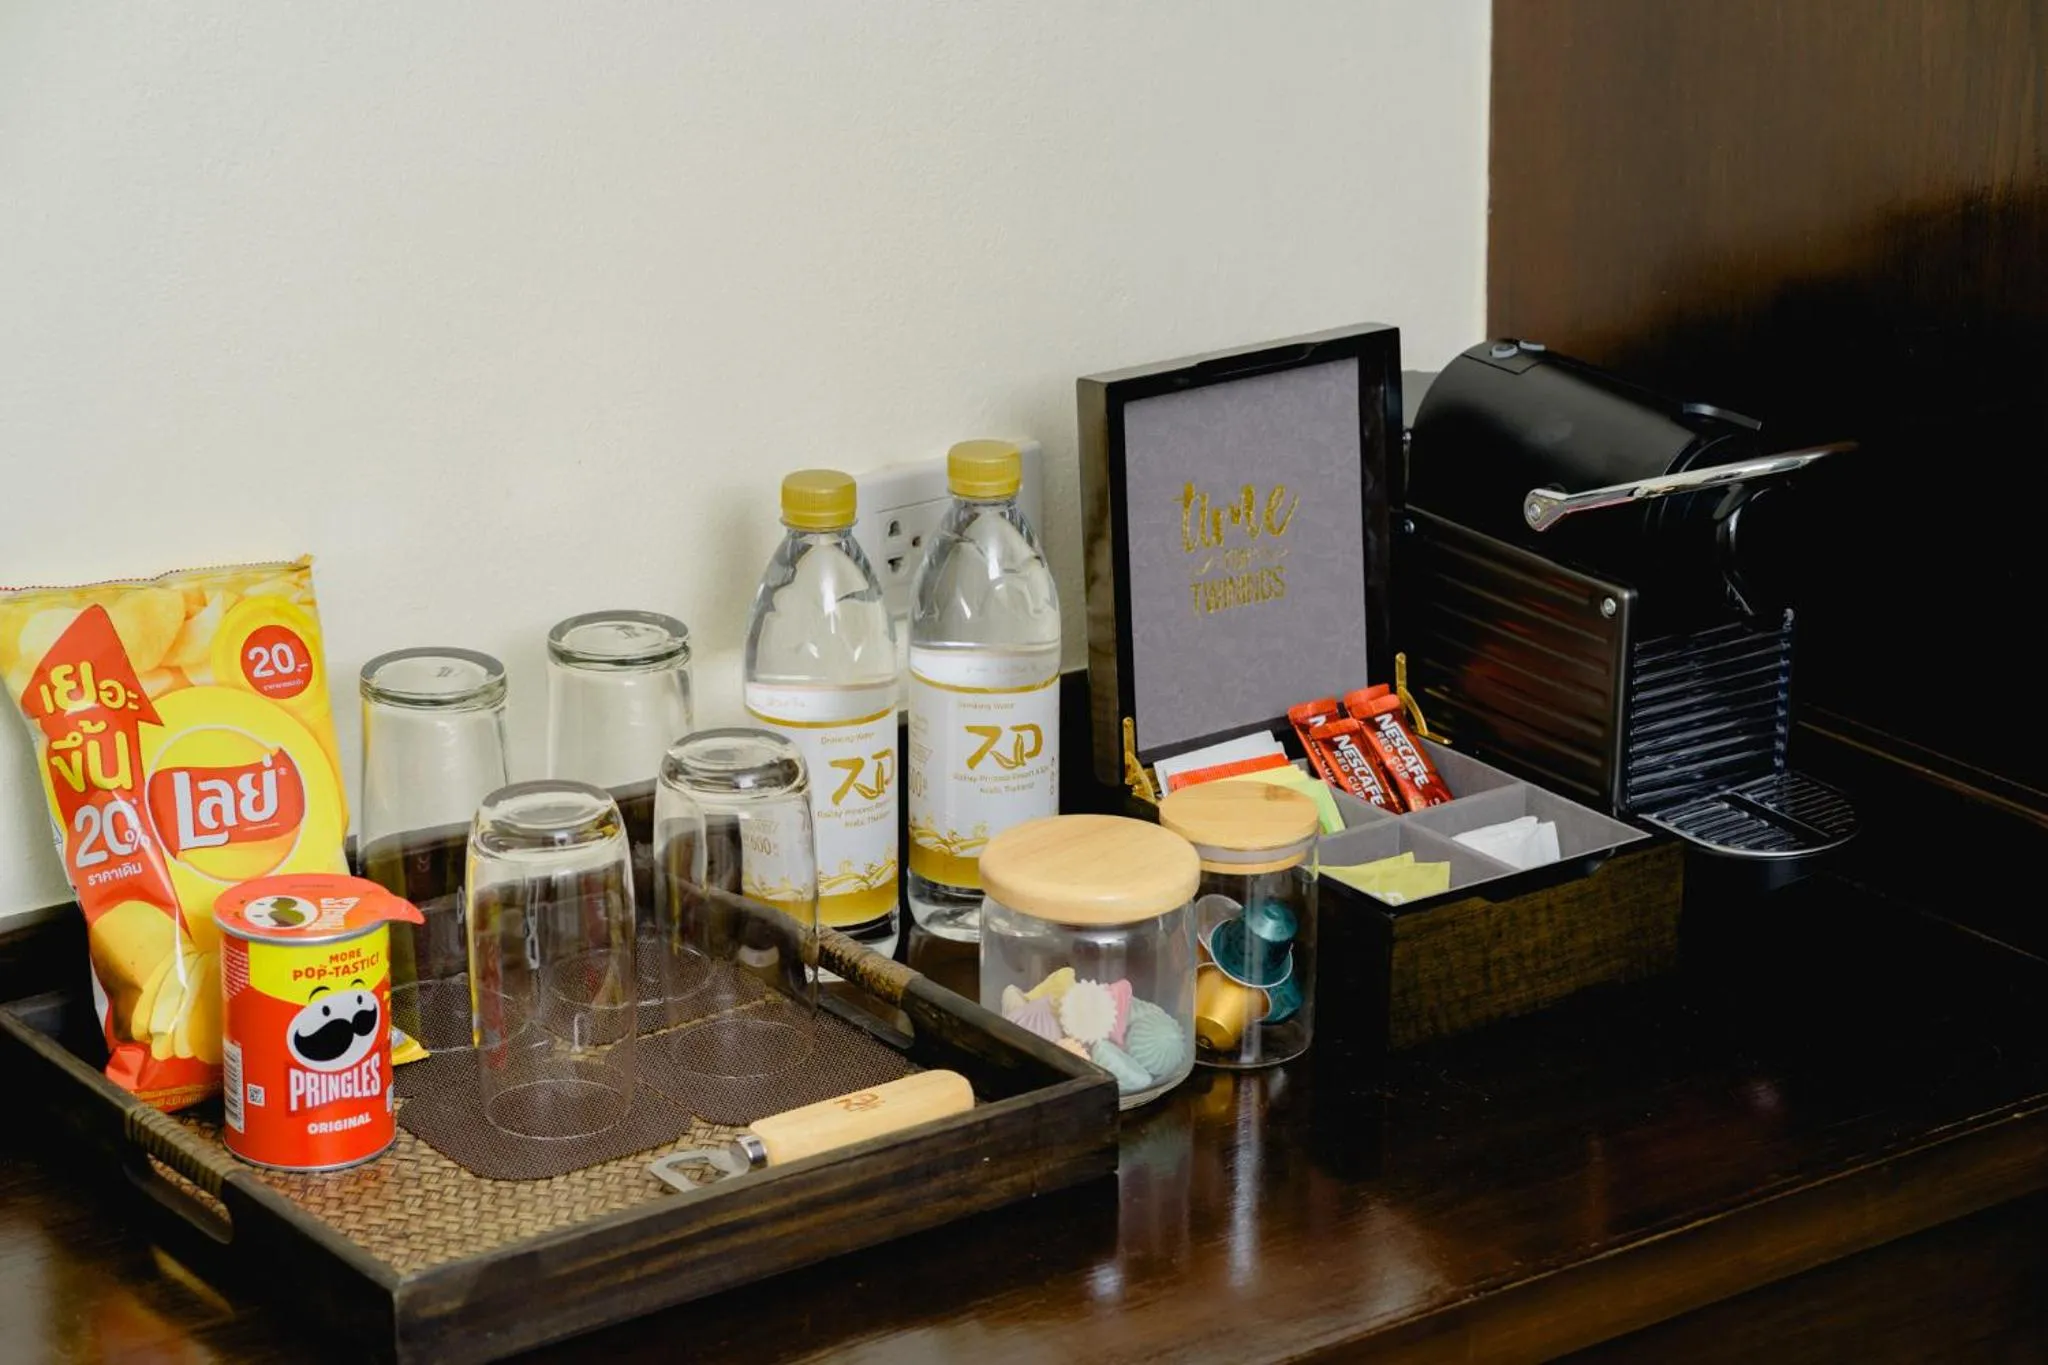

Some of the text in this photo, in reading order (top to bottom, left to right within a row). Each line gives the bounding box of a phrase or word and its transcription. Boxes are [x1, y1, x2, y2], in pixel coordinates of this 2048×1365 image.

[40, 660, 140, 715] เยอะ
[50, 719, 133, 793] ขึ้น
[1333, 750, 1367, 799] RED CUP
[1376, 731, 1411, 780] RED CUP
[87, 862, 143, 886] ราคาเดิม
[292, 951, 380, 981] POP-TASTIC!
[329, 947, 362, 964] MORE
[288, 1051, 382, 1112] PRINGLES
[307, 1111, 372, 1135] ORIGINAL
